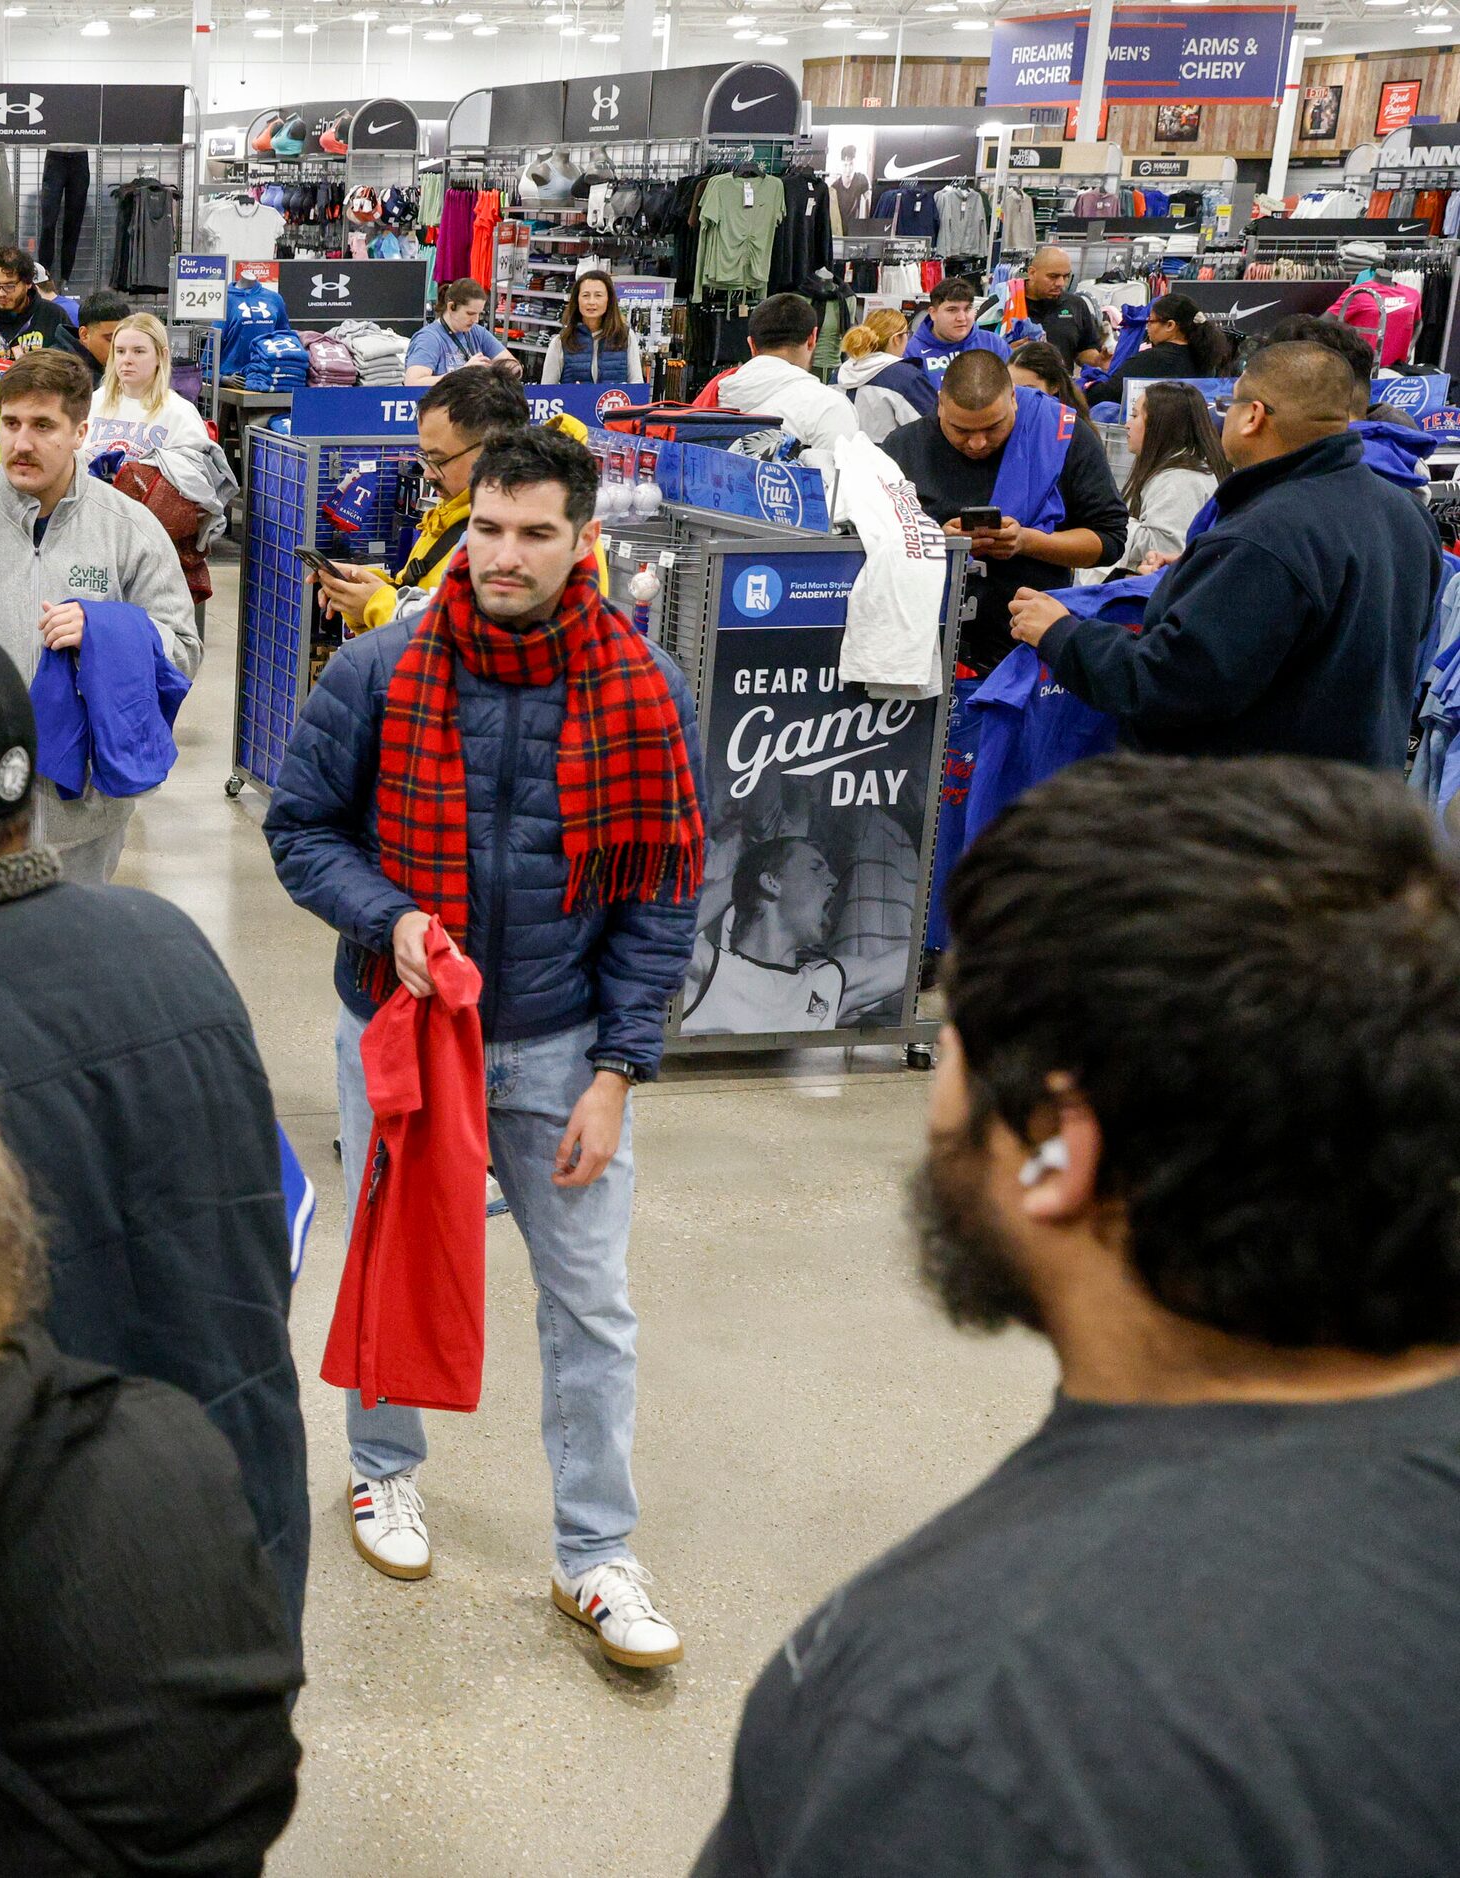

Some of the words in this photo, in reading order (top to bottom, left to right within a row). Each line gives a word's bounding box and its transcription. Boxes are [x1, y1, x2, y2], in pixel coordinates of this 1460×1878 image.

[1011, 41, 1074, 65] FIREARMS
[1106, 46, 1151, 62] MEN'S
[1182, 37, 1239, 56] ARMS
[1244, 37, 1259, 56] &
[1179, 61, 1246, 80] CHERY
[180, 258, 197, 267] Our
[180, 266, 199, 274] Low
[199, 266, 222, 275] Price
[1384, 296, 1406, 306] NIKE
[1387, 385, 1423, 404] Fun
[764, 465, 781, 476] HAVE
[759, 474, 793, 509] Fun
[902, 525, 922, 560] 2023
[81, 565, 109, 581] vital
[68, 577, 109, 594] caring
[789, 590, 833, 599] ACADEMY
[790, 581, 807, 590] Find
[808, 581, 828, 590] More
[828, 581, 853, 591] Styles
[733, 667, 808, 695] GEAR
[726, 698, 916, 799] Game
[830, 769, 909, 807] DAY
